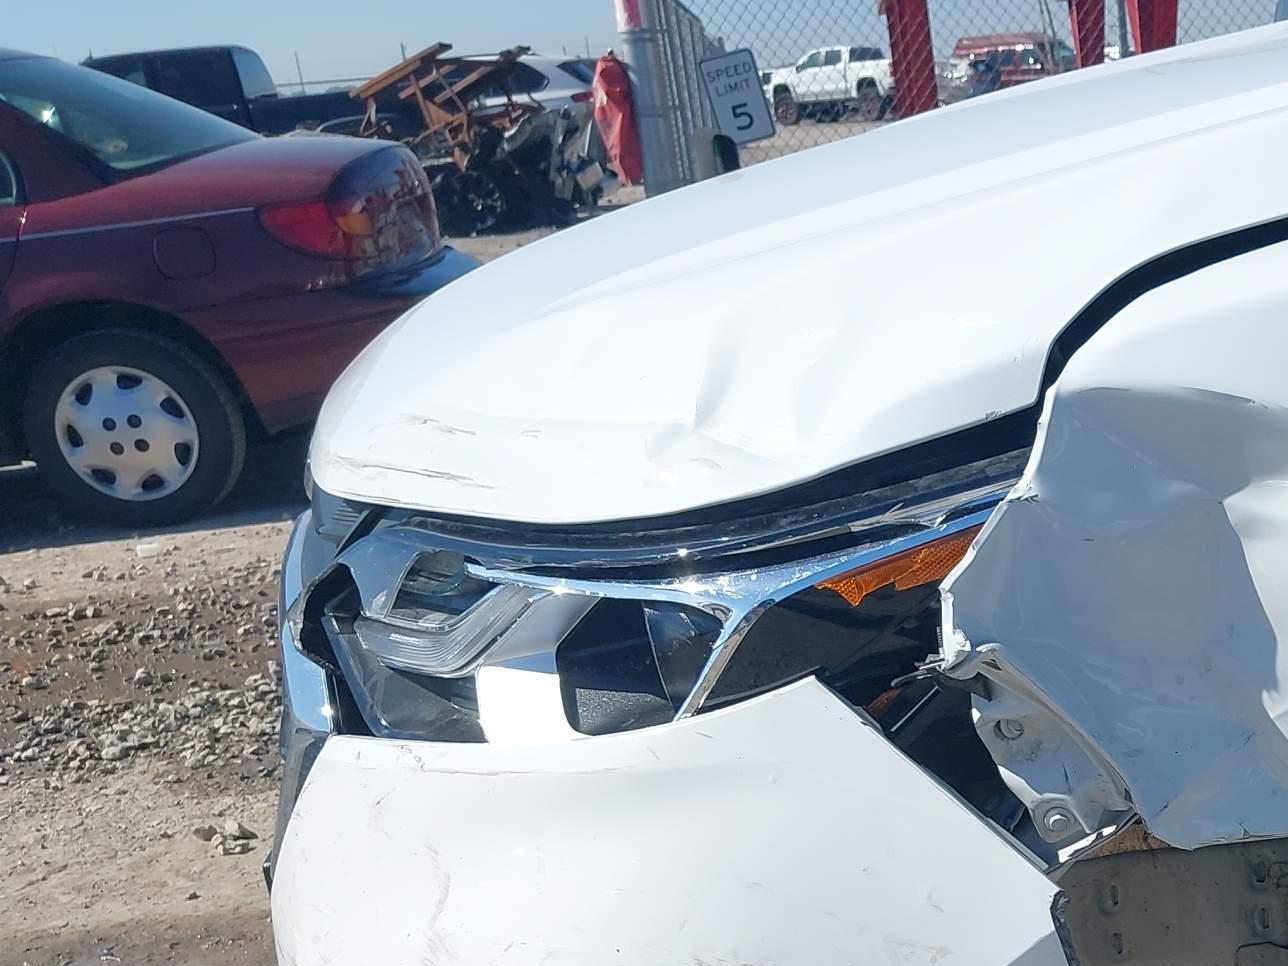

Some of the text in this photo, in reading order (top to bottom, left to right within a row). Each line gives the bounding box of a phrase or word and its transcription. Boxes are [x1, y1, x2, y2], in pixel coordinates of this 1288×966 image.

[706, 62, 752, 83] SPEED
[715, 78, 751, 98] LIMIT
[731, 102, 754, 131] 5
